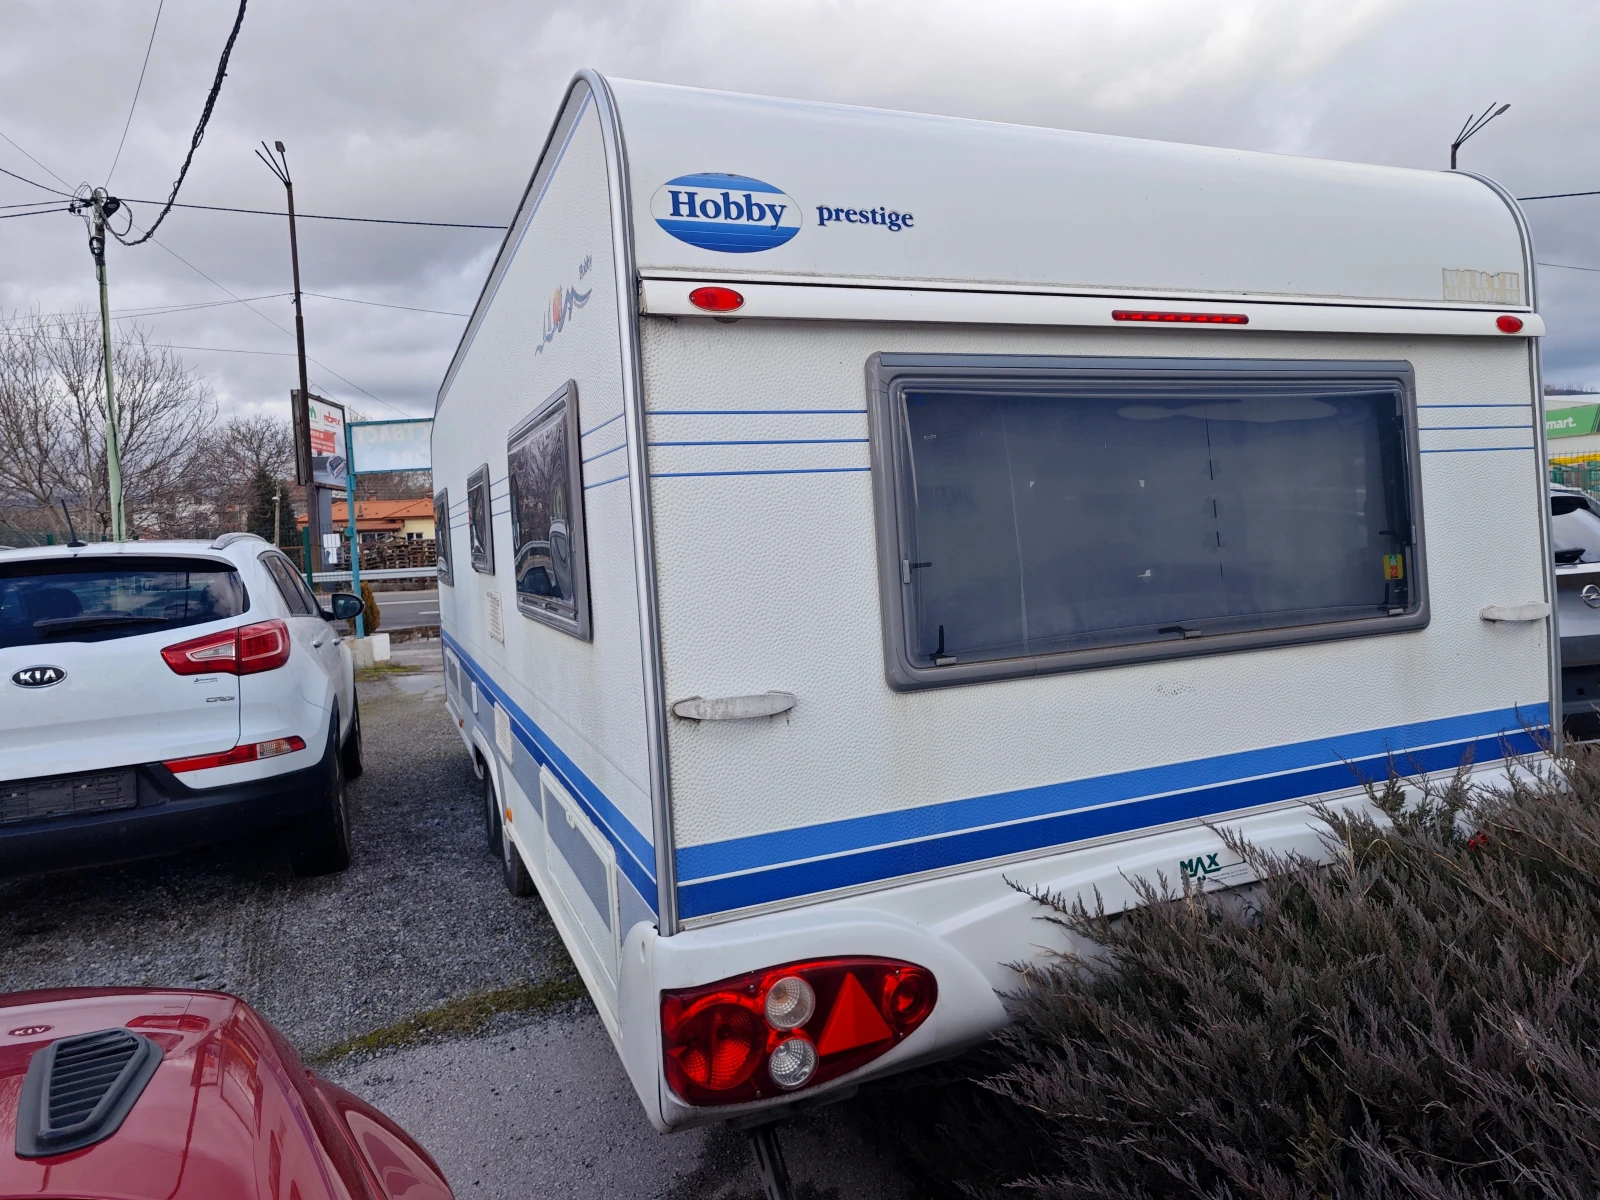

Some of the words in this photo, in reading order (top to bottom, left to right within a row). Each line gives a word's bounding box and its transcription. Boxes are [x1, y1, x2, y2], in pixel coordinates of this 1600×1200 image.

[668, 190, 787, 230] Hobby
[816, 204, 914, 232] prestige
[19, 669, 57, 684] KIA
[1180, 852, 1220, 877] MAX
